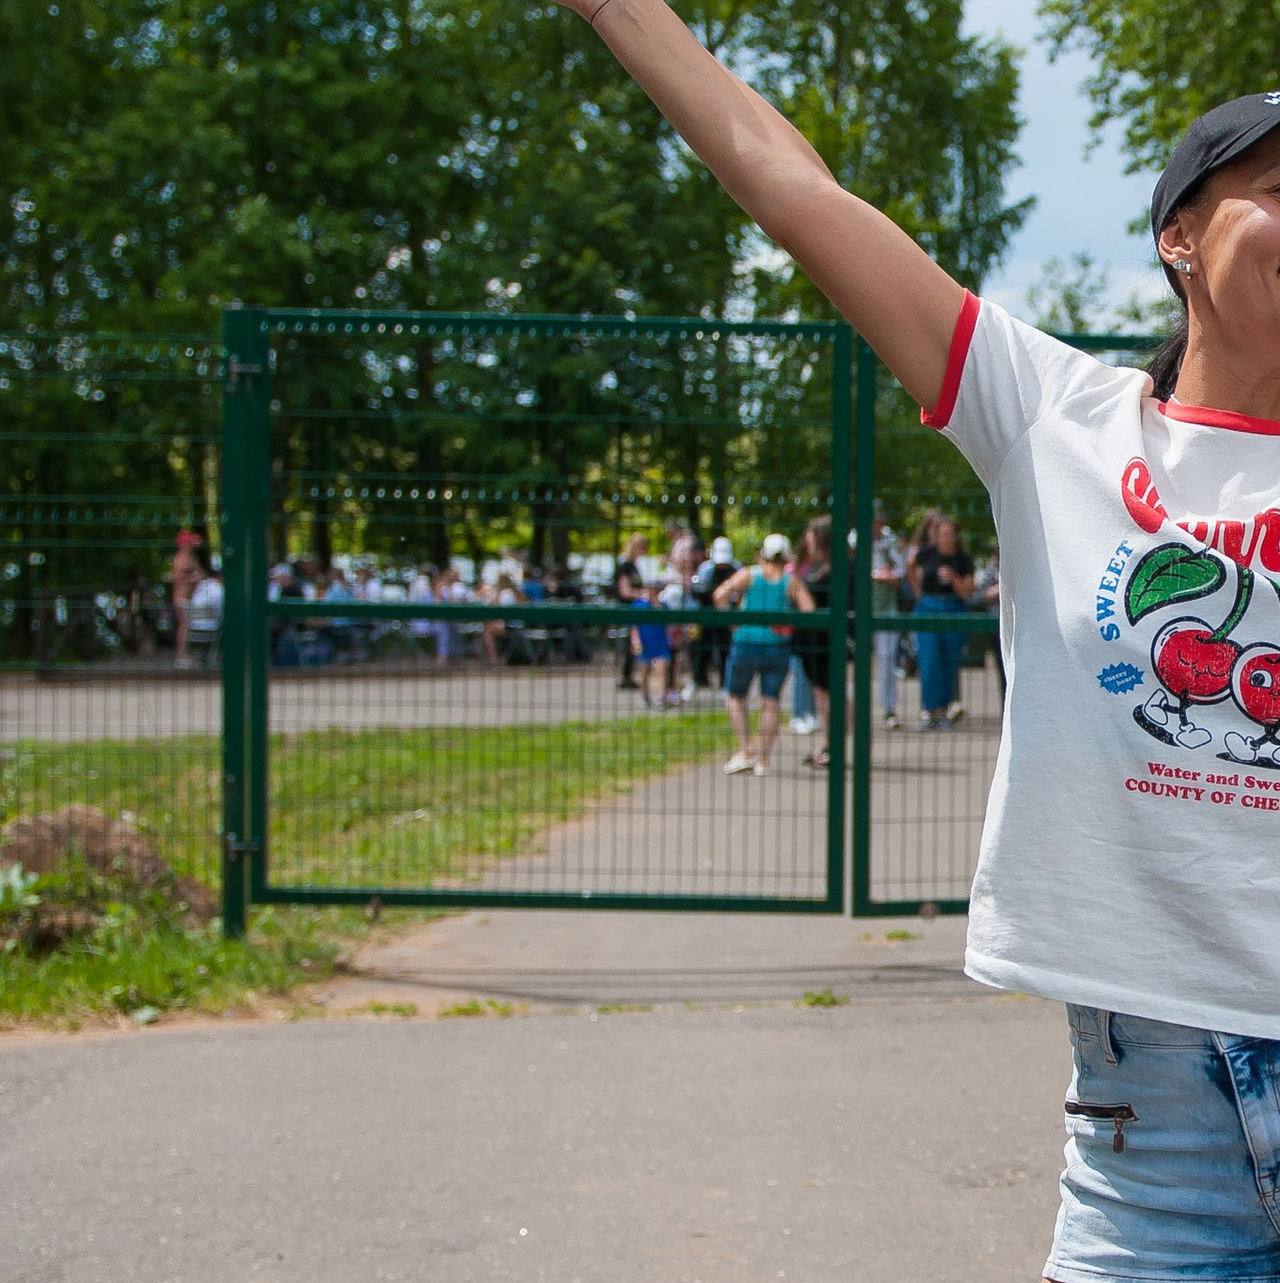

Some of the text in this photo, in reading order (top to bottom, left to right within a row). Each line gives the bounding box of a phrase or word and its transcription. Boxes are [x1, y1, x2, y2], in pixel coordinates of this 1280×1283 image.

[1096, 539, 1134, 642] SWEET
[1147, 762, 1201, 781] Water
[1205, 773, 1239, 787] and
[1125, 778, 1206, 801] COUNTY
[1210, 791, 1237, 805] OF
